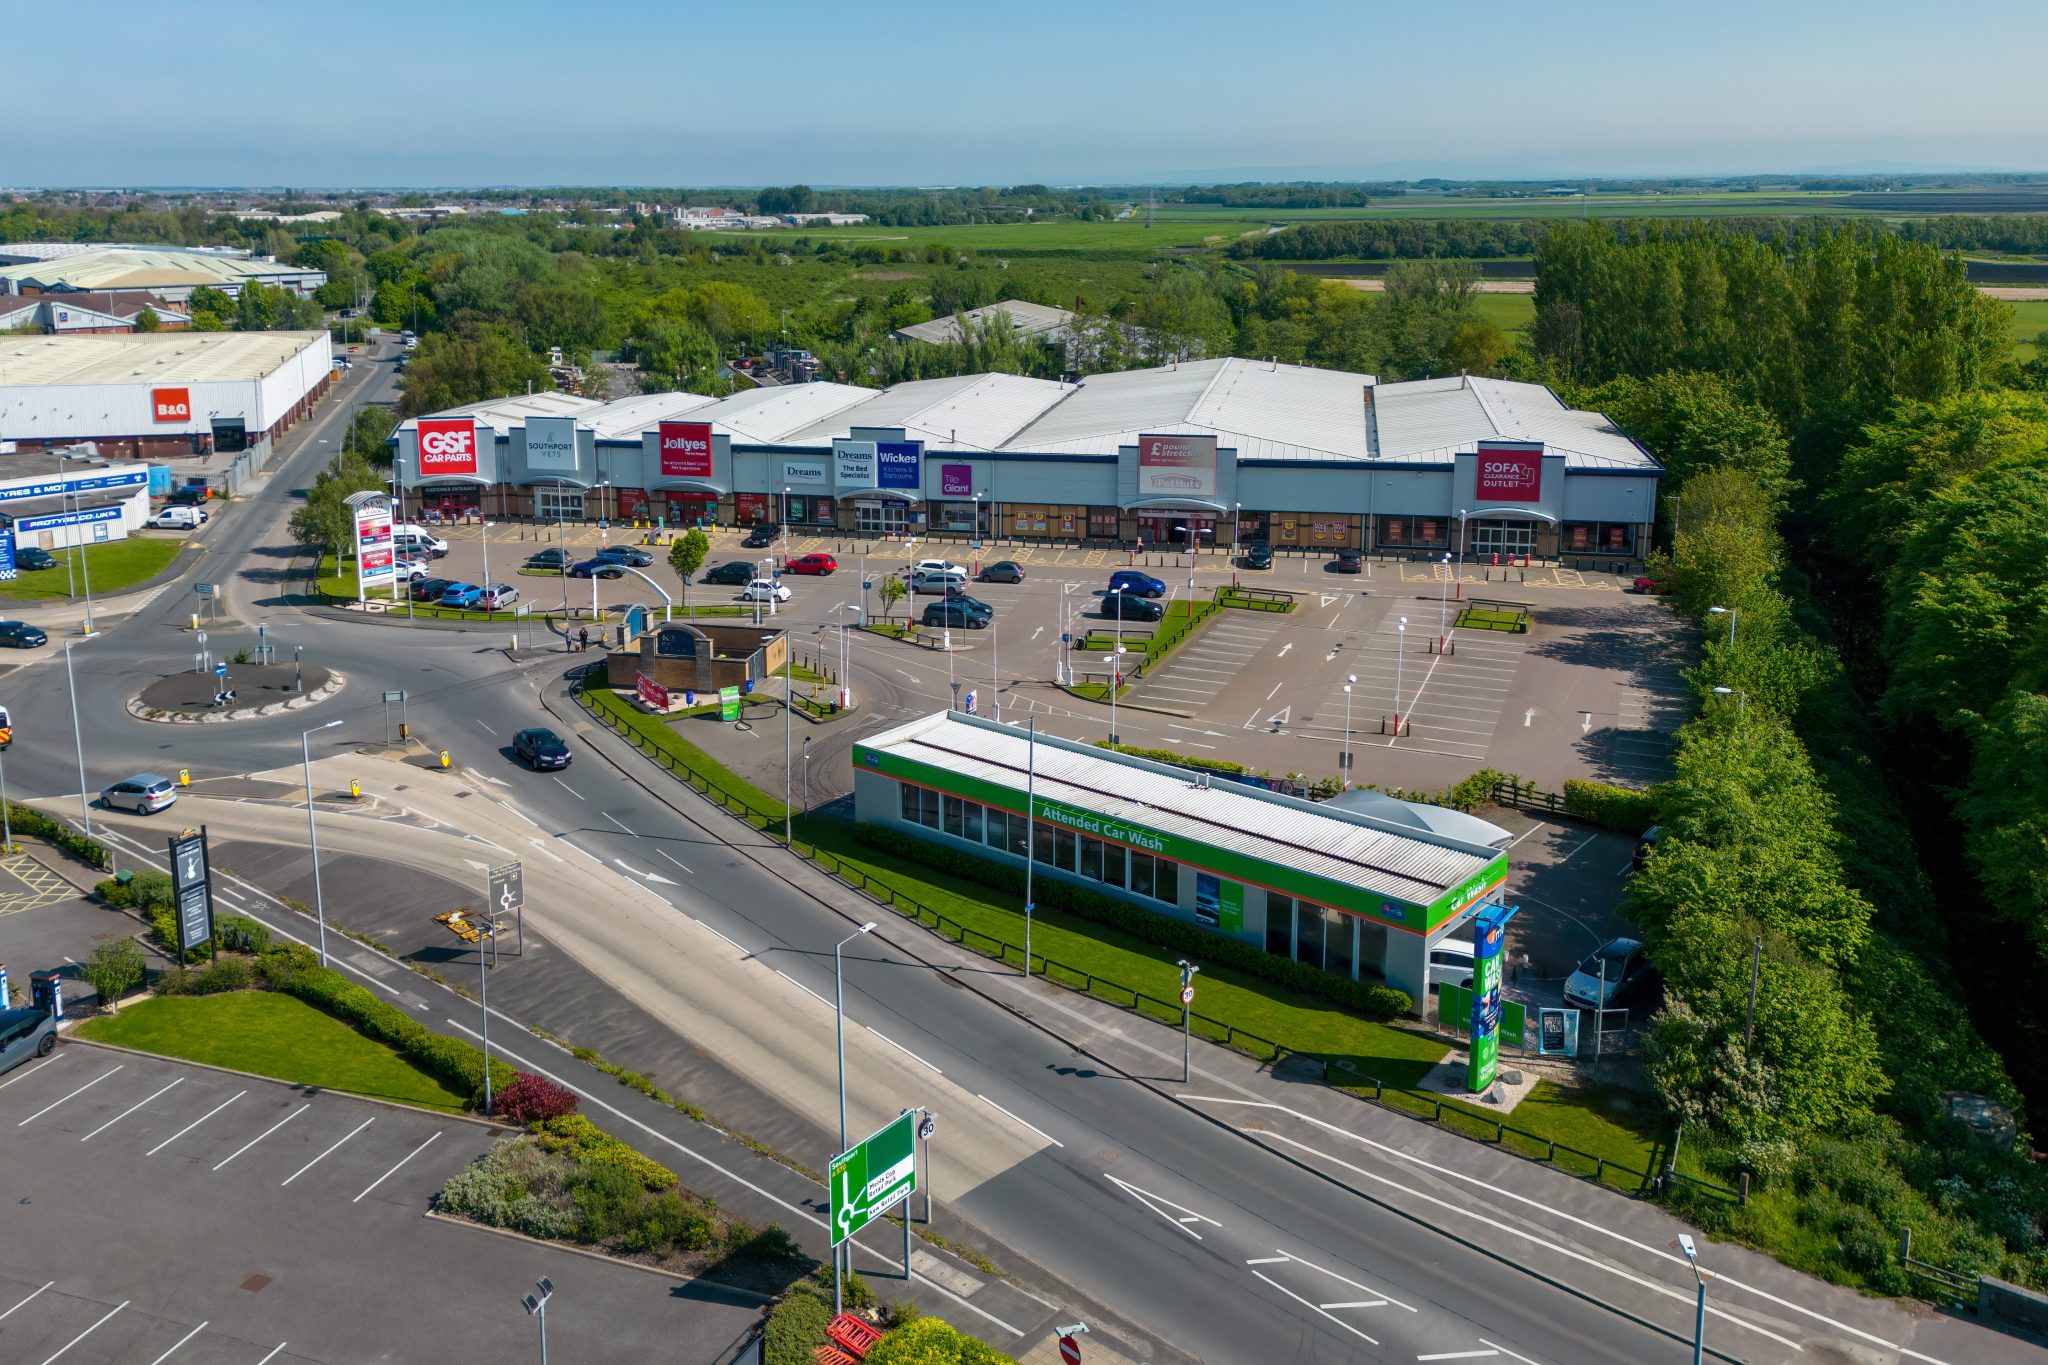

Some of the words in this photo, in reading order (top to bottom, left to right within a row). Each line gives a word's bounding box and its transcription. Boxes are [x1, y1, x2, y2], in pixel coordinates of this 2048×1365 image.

[158, 403, 188, 416] B&Q
[422, 431, 471, 454] GSF
[528, 442, 573, 451] SOUTHPORT
[663, 438, 707, 451] Jollyes
[1150, 442, 1161, 456] £
[424, 454, 444, 463] CAR
[444, 453, 472, 463] PARTS
[541, 450, 562, 458] VETS
[837, 450, 873, 460] Dreams
[880, 452, 917, 464] Wickes
[787, 466, 822, 476] Dreams
[1484, 462, 1520, 473] SOFA
[944, 475, 959, 483] Tile
[1483, 480, 1520, 488] OUTLET
[33, 485, 42, 493] &
[44, 483, 67, 493] MOT
[944, 484, 969, 493] Giant
[30, 511, 109, 529] PROTYRE.CO.UK
[1042, 806, 1100, 833] Attended
[1103, 824, 1125, 840] Car
[1128, 830, 1163, 852] Wash
[1451, 896, 1464, 911] Car
[1466, 877, 1487, 900] Wash
[1485, 954, 1500, 977] CAR
[1484, 969, 1502, 992] WAS
[1185, 989, 1193, 1000] 30
[923, 1123, 934, 1137] 30
[831, 1149, 858, 1170] Southport
[868, 1184, 884, 1198] Retail
[884, 1176, 897, 1187] Park
[869, 1206, 880, 1216] Kew
[881, 1192, 896, 1207] Retail
[896, 1185, 909, 1196] Park
